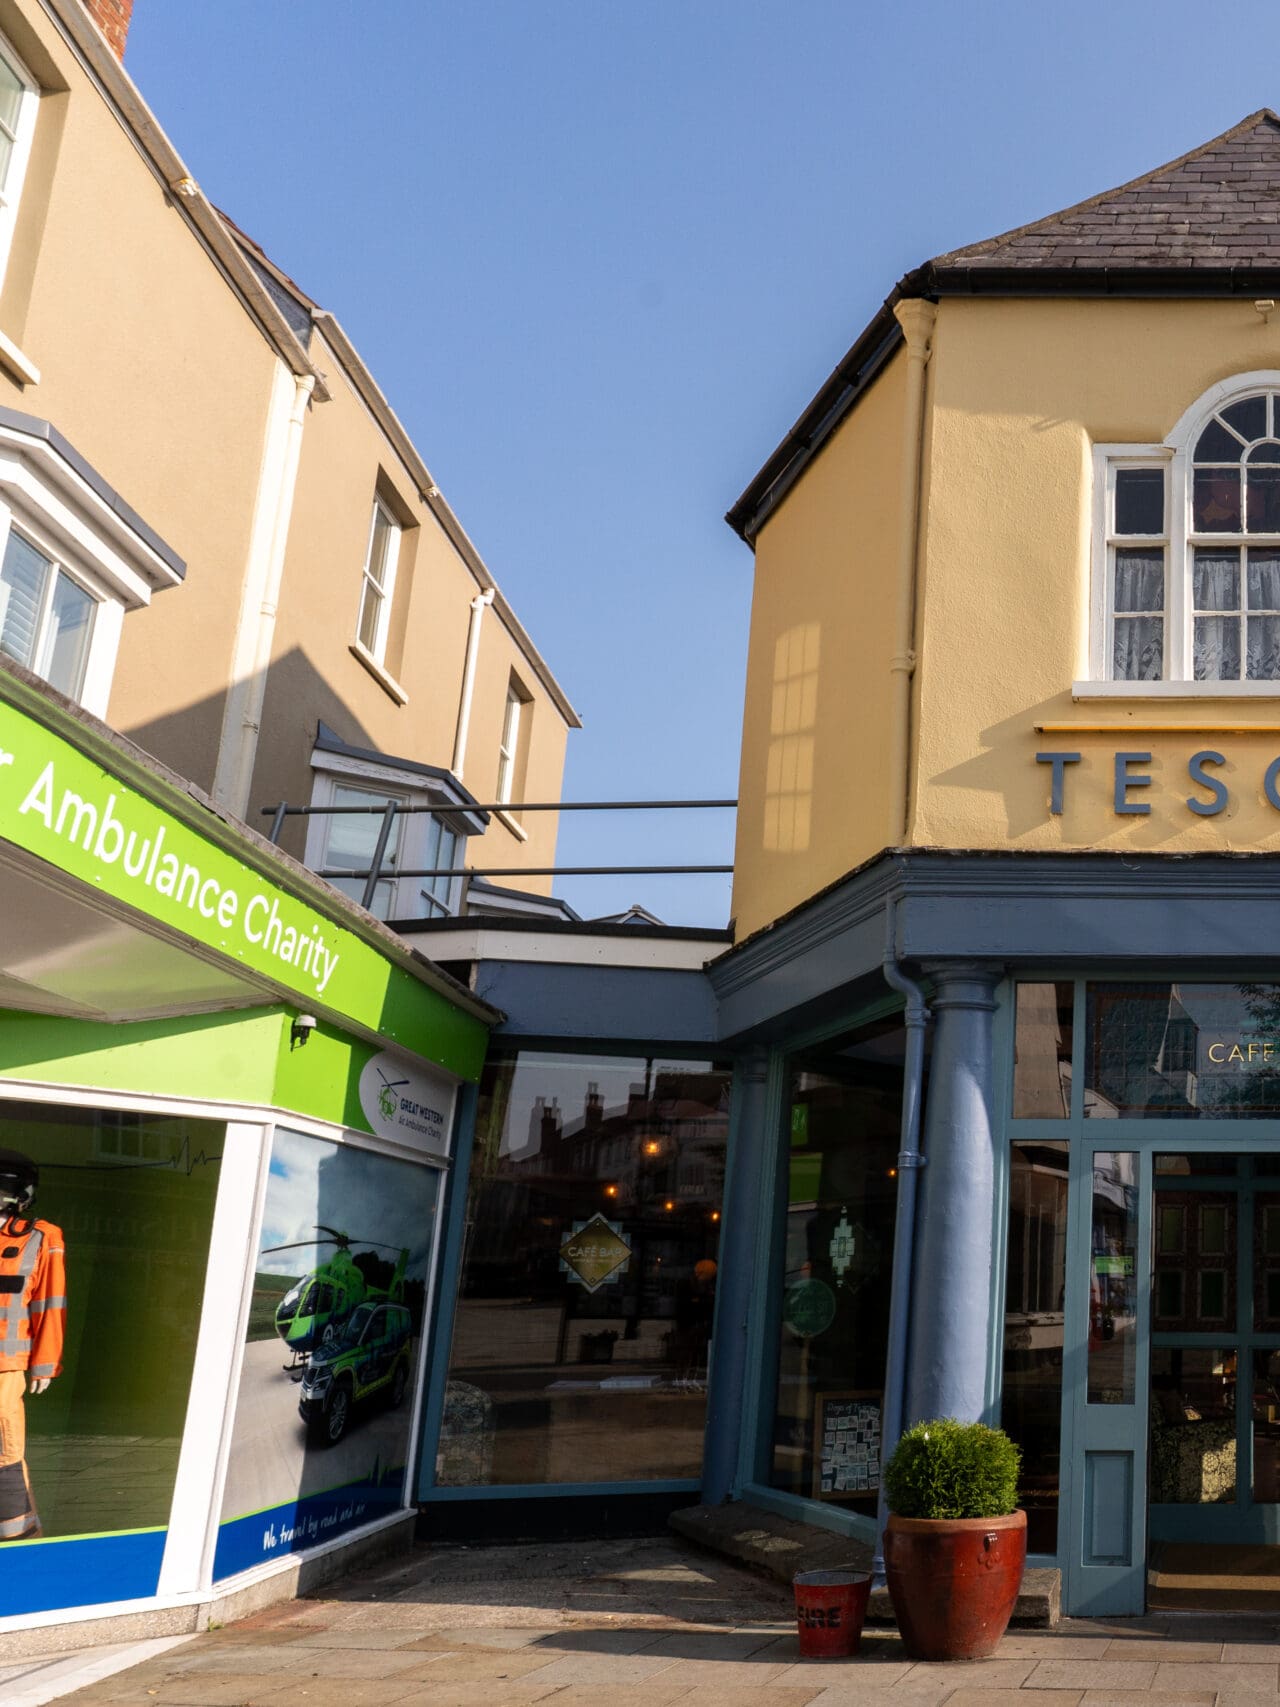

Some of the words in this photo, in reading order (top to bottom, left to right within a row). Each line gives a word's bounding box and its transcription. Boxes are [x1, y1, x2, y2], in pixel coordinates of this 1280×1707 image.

[18, 761, 238, 928] Ambulance
[244, 895, 340, 992] Charity
[400, 1098, 419, 1115] GREAT
[419, 1105, 444, 1125] WESTERN
[405, 1119, 428, 1135] Ambulance
[428, 1126, 442, 1140] Charity
[599, 1247, 622, 1257] BAR
[263, 1523, 277, 1551] We
[280, 1516, 306, 1545] travel
[307, 1515, 318, 1539] by
[320, 1507, 338, 1529] road
[340, 1499, 354, 1521] and
[355, 1501, 366, 1515] air
